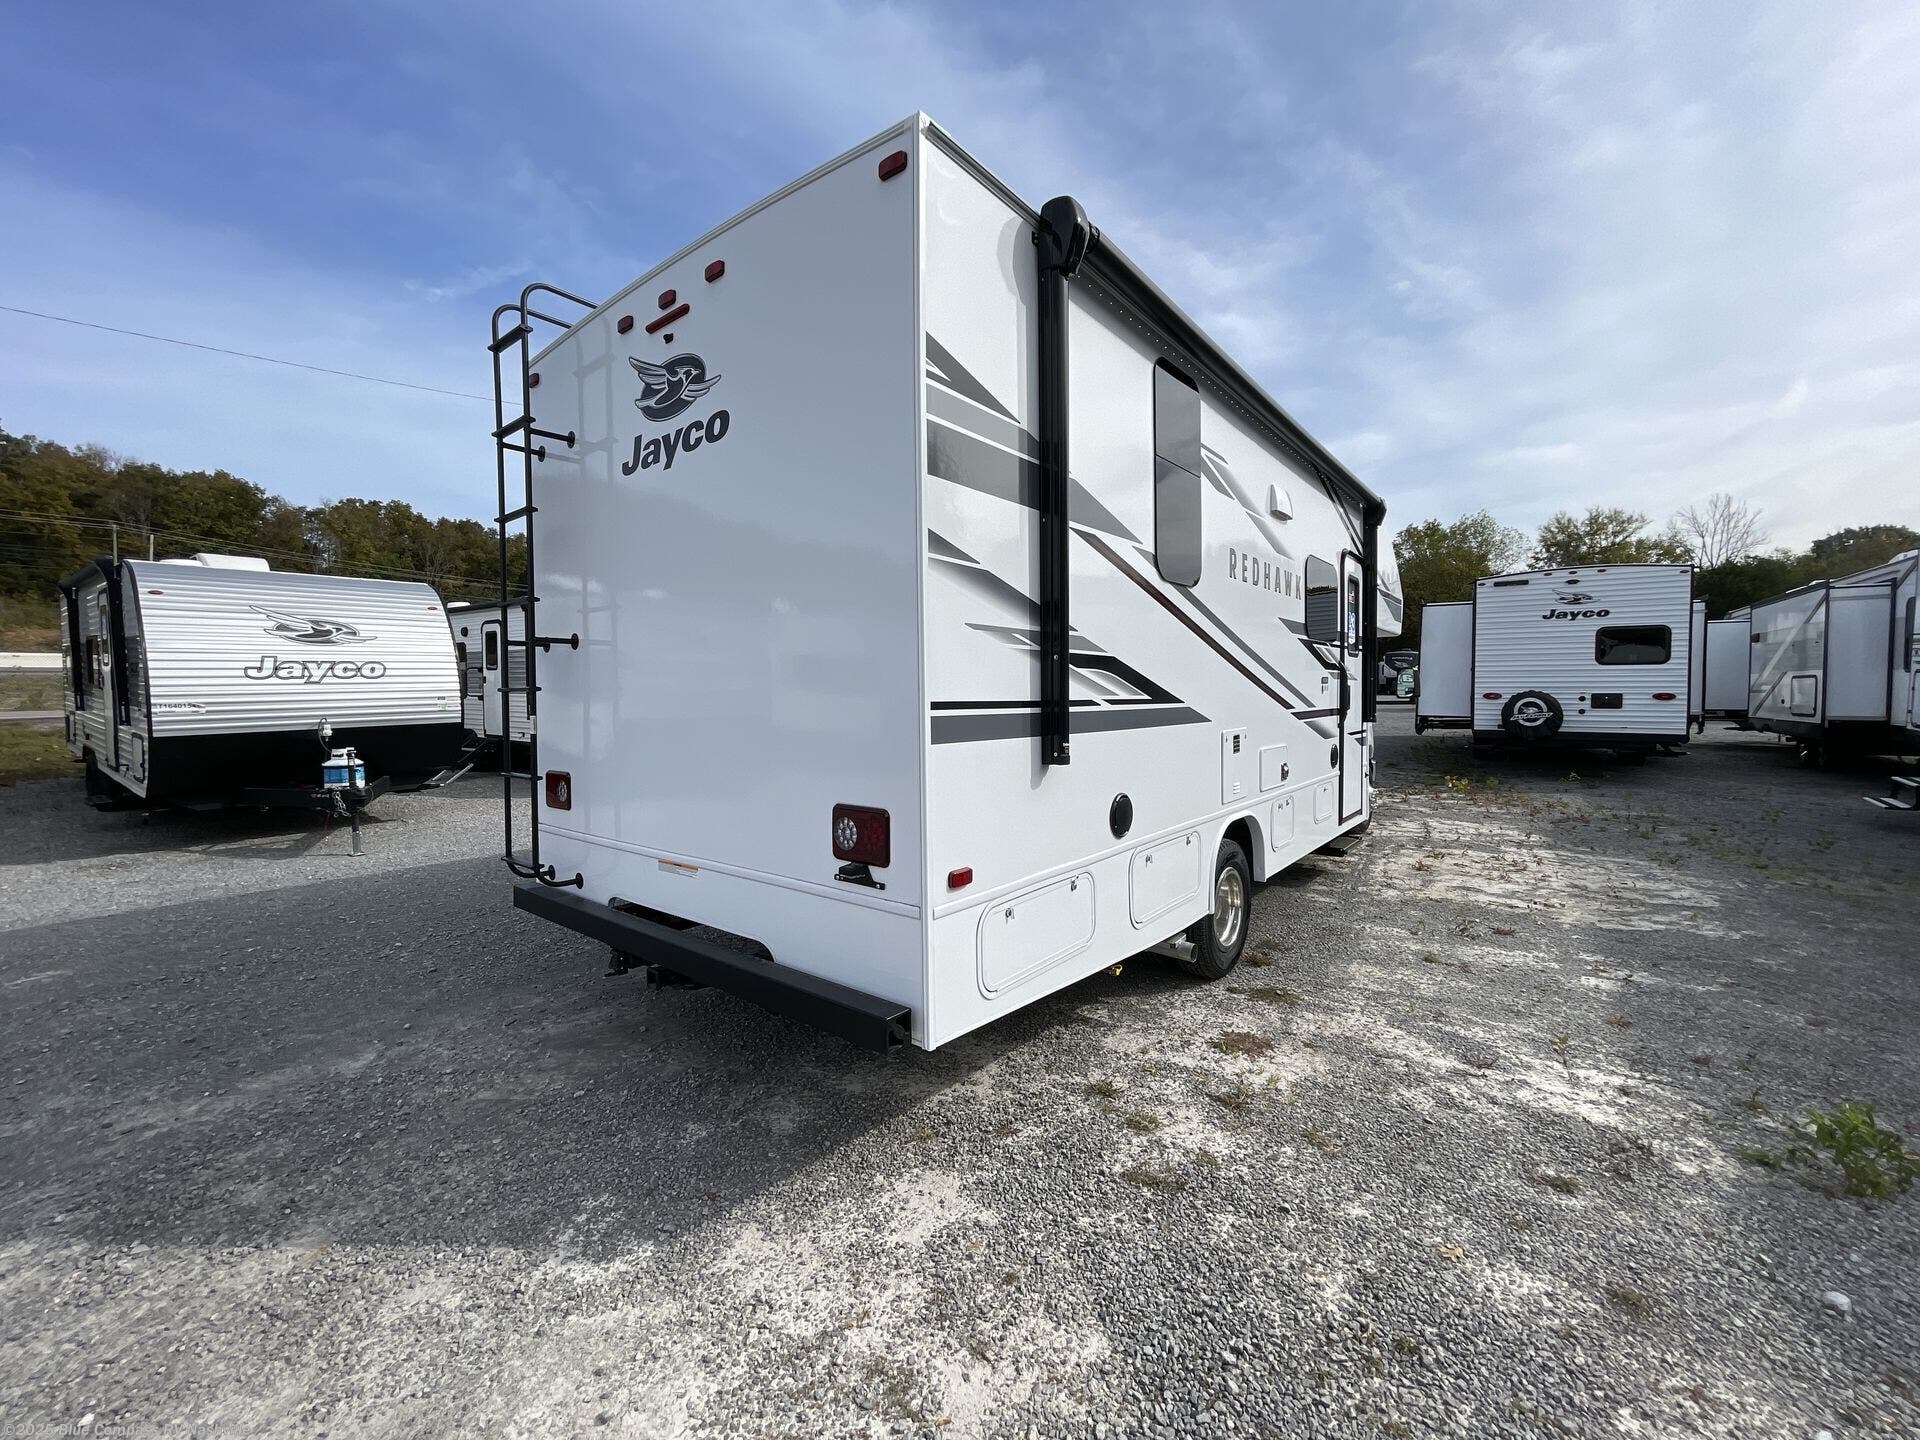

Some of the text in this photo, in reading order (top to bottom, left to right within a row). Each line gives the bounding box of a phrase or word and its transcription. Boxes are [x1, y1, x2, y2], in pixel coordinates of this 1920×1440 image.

[621, 409, 730, 476] Jayco
[1229, 547, 1301, 601] REDHAWK
[1542, 608, 1610, 621] Jayco
[243, 655, 387, 684] Jayco
